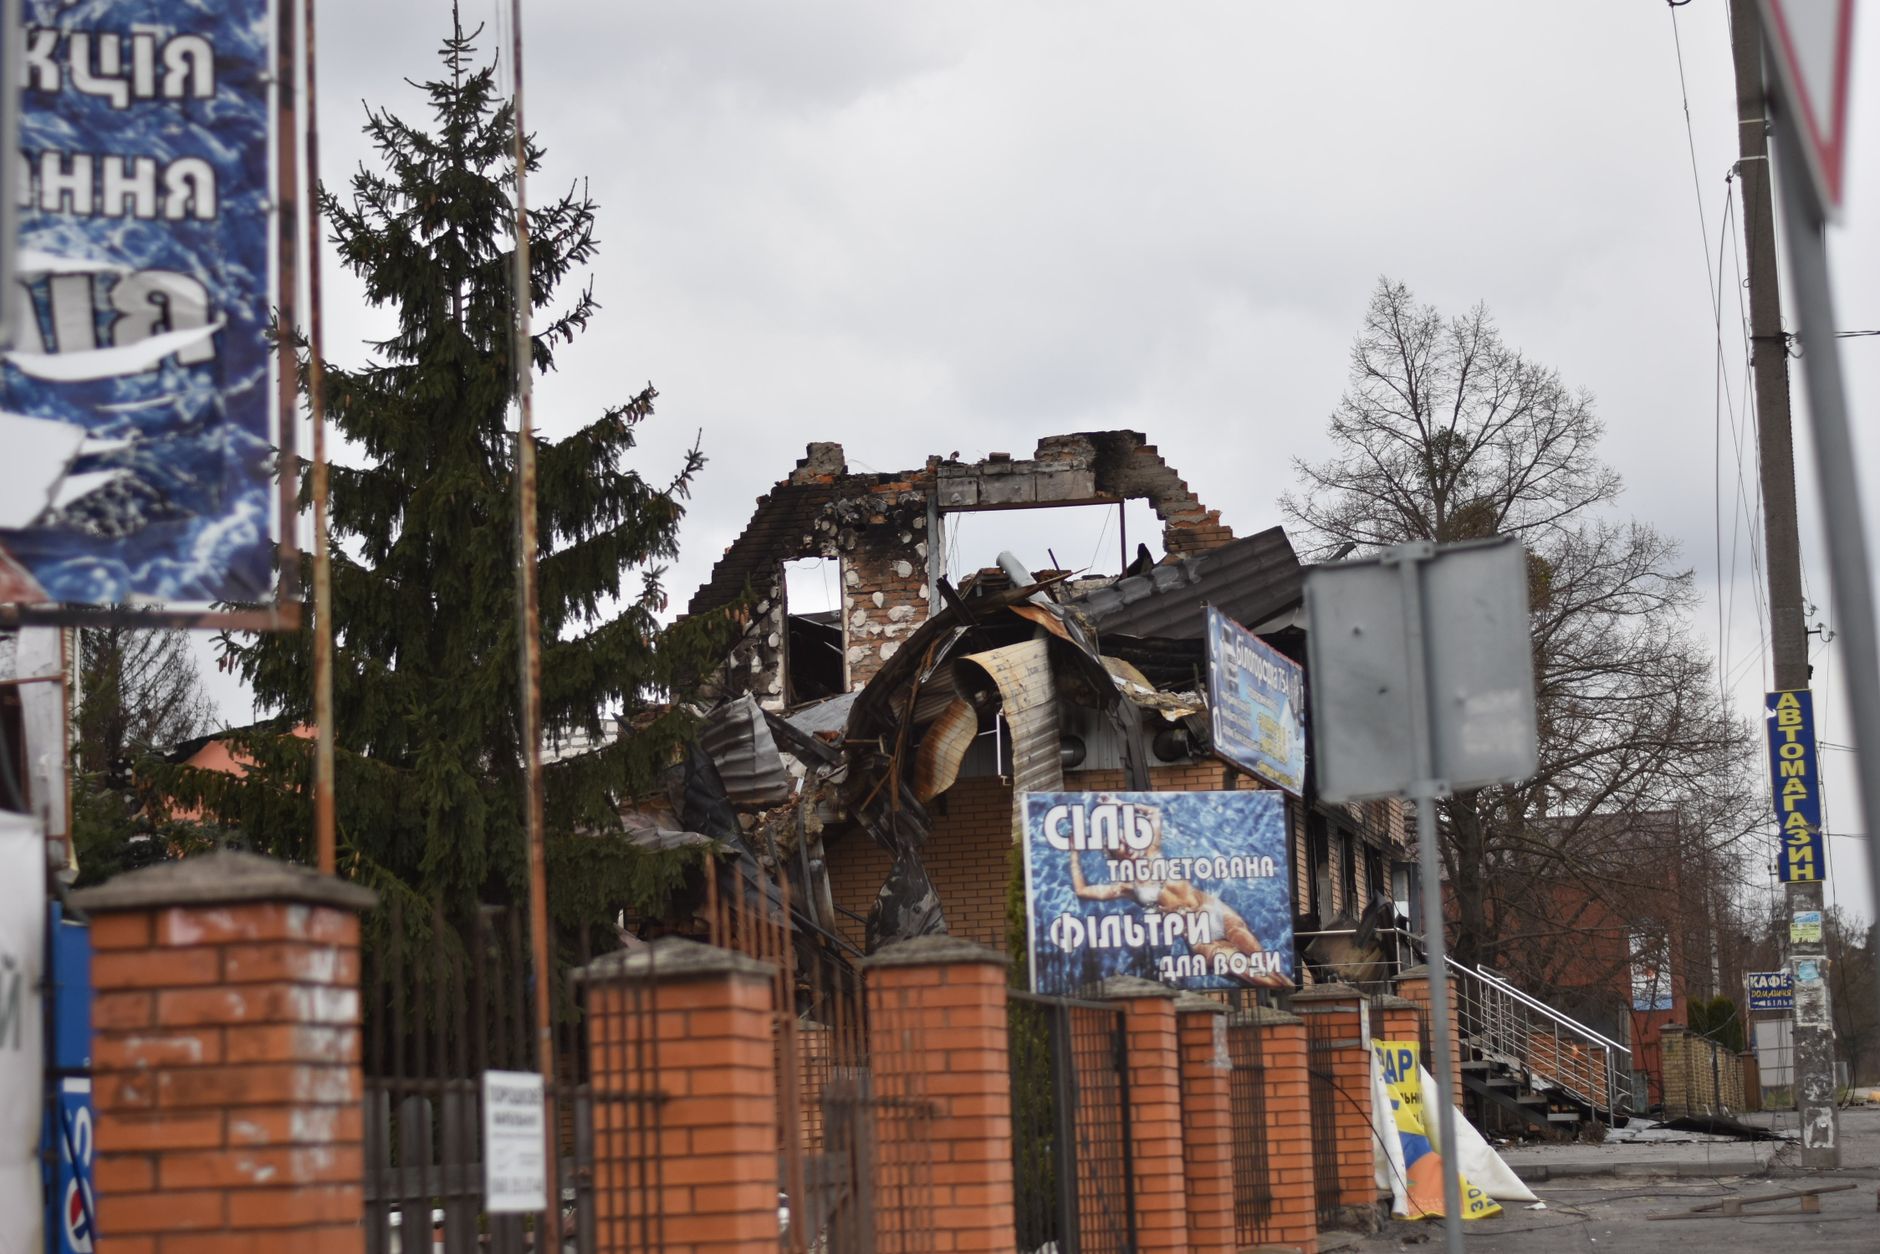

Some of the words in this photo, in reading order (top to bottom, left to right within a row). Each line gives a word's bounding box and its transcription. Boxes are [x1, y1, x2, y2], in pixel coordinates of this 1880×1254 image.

[1776, 692, 1814, 881] АВТОМАГАЗИН
[1043, 803, 1154, 851] СІЛЬ
[1107, 855, 1275, 882] ТАБЛЕТОВАНА
[1050, 911, 1212, 953] ФІЛЬТРИ
[1159, 954, 1207, 981] ДЛЯ
[1213, 951, 1281, 978] ВОДИ
